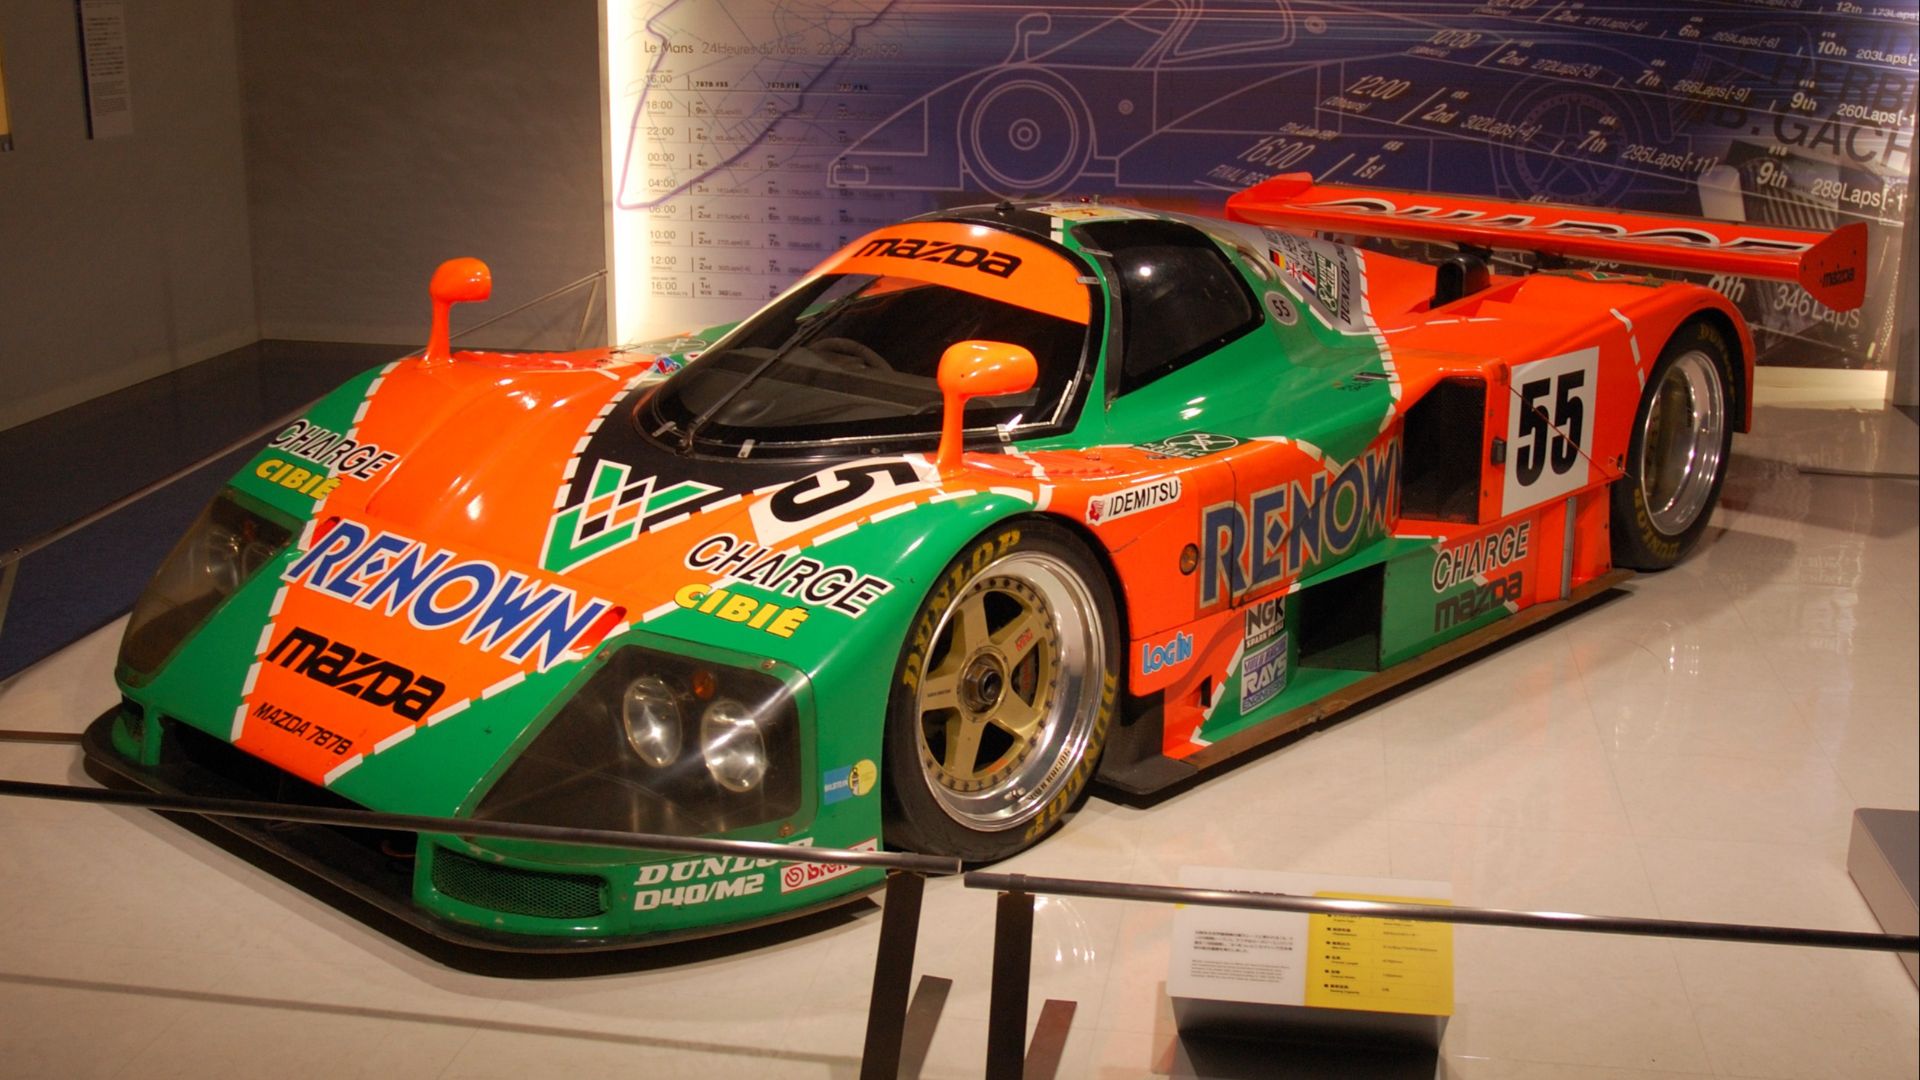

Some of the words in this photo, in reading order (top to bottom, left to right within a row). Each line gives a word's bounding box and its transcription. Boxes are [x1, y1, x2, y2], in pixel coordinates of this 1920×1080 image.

[644, 42, 657, 54] Le
[662, 43, 694, 54] Mans
[1817, 40, 1848, 57] 10th
[1346, 75, 1411, 100] 12:00
[1635, 69, 1662, 87] 7th
[1673, 79, 1751, 102] 266Laps[-9]
[1790, 92, 1818, 112] 9th
[1421, 103, 1459, 124] 2nd
[1460, 114, 1543, 142] 302Laps[-4]
[1236, 135, 1317, 171] 16:00
[1352, 154, 1388, 181] 1st
[1577, 130, 1608, 154] 7th
[1621, 144, 1720, 177] 295Laps[-11]
[1755, 161, 1789, 189] 9th
[650, 230, 677, 240] 10:00
[651, 256, 677, 265] 12:00
[651, 281, 678, 291] 16:00
[1271, 299, 1291, 318] 55
[1516, 369, 1585, 487] 55
[268, 418, 400, 482] CHARGE
[1107, 479, 1181, 517] IDEMITSU
[1199, 438, 1400, 609] RENOW
[1432, 519, 1531, 594] CHARGE
[684, 533, 895, 619] CHARGE
[280, 518, 613, 673] RENOWN
[1246, 597, 1287, 637] NGK
[1243, 654, 1288, 700] RAYS
[252, 701, 310, 739] MAZDA
[303, 723, 353, 756] 787B
[633, 873, 765, 911] D40/M2
